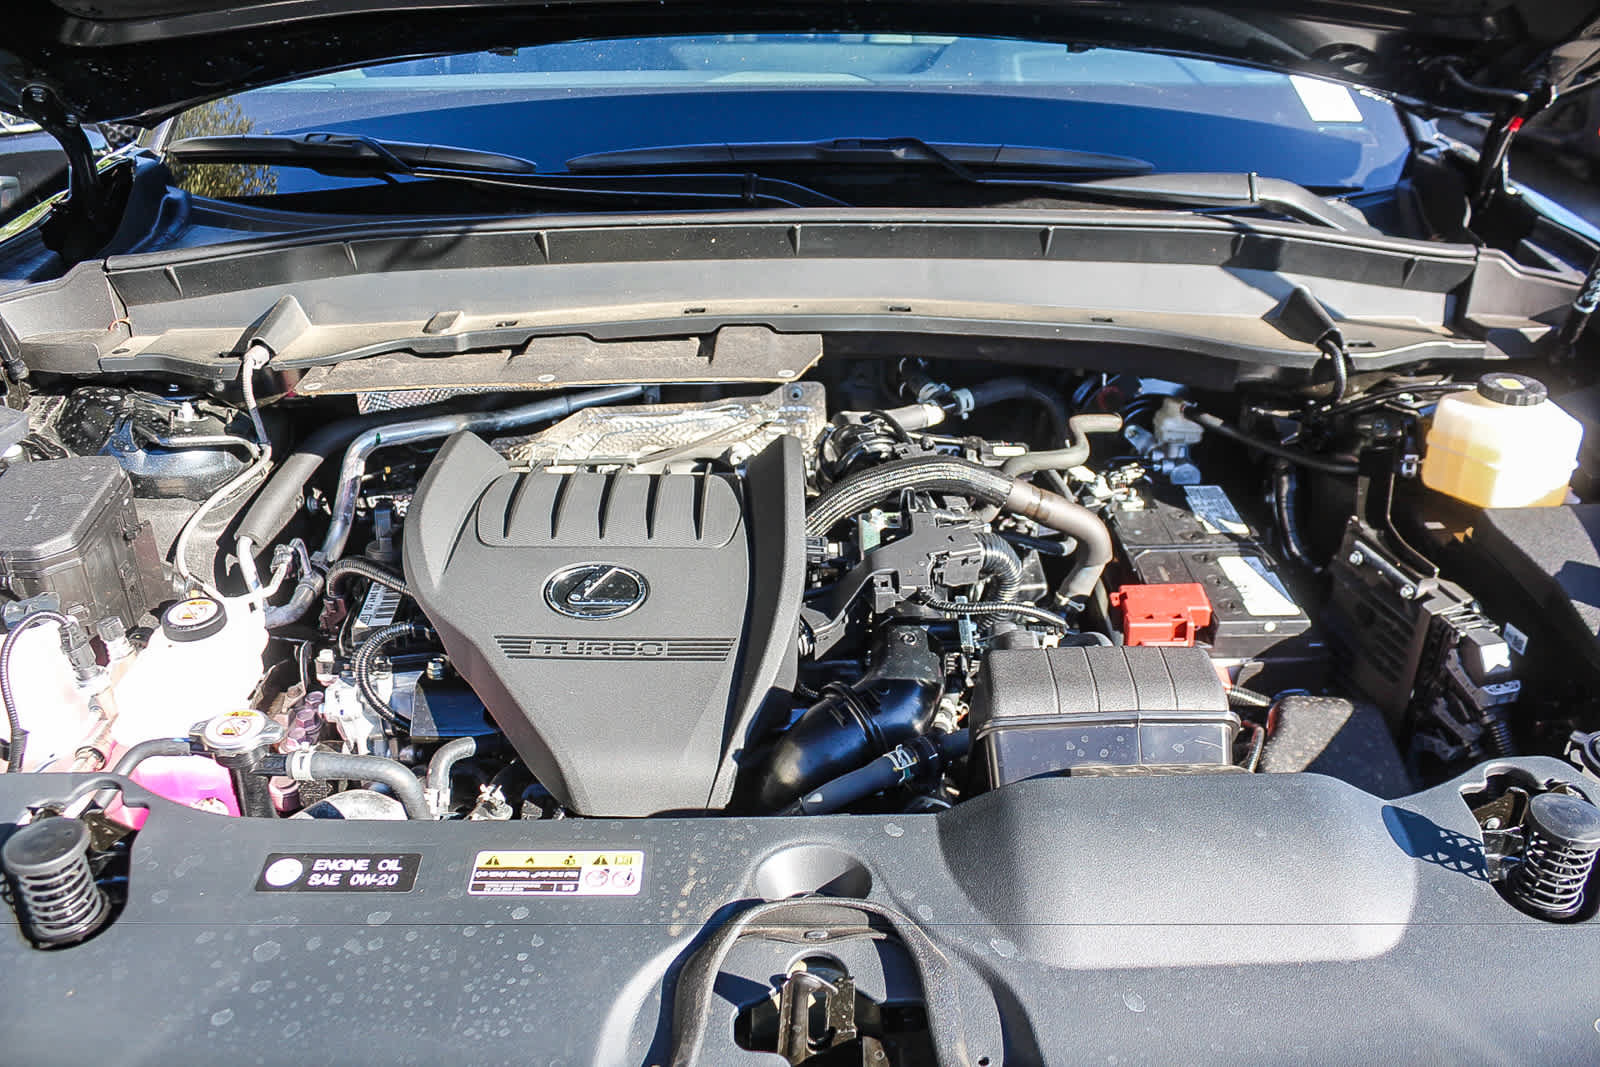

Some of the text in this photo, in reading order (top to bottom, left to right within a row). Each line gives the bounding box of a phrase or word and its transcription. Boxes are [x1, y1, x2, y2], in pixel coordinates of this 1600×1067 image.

[534, 639, 664, 657] TURBO
[312, 858, 403, 871] ENGINE OIL
[307, 873, 399, 887] SAE 0W-20
